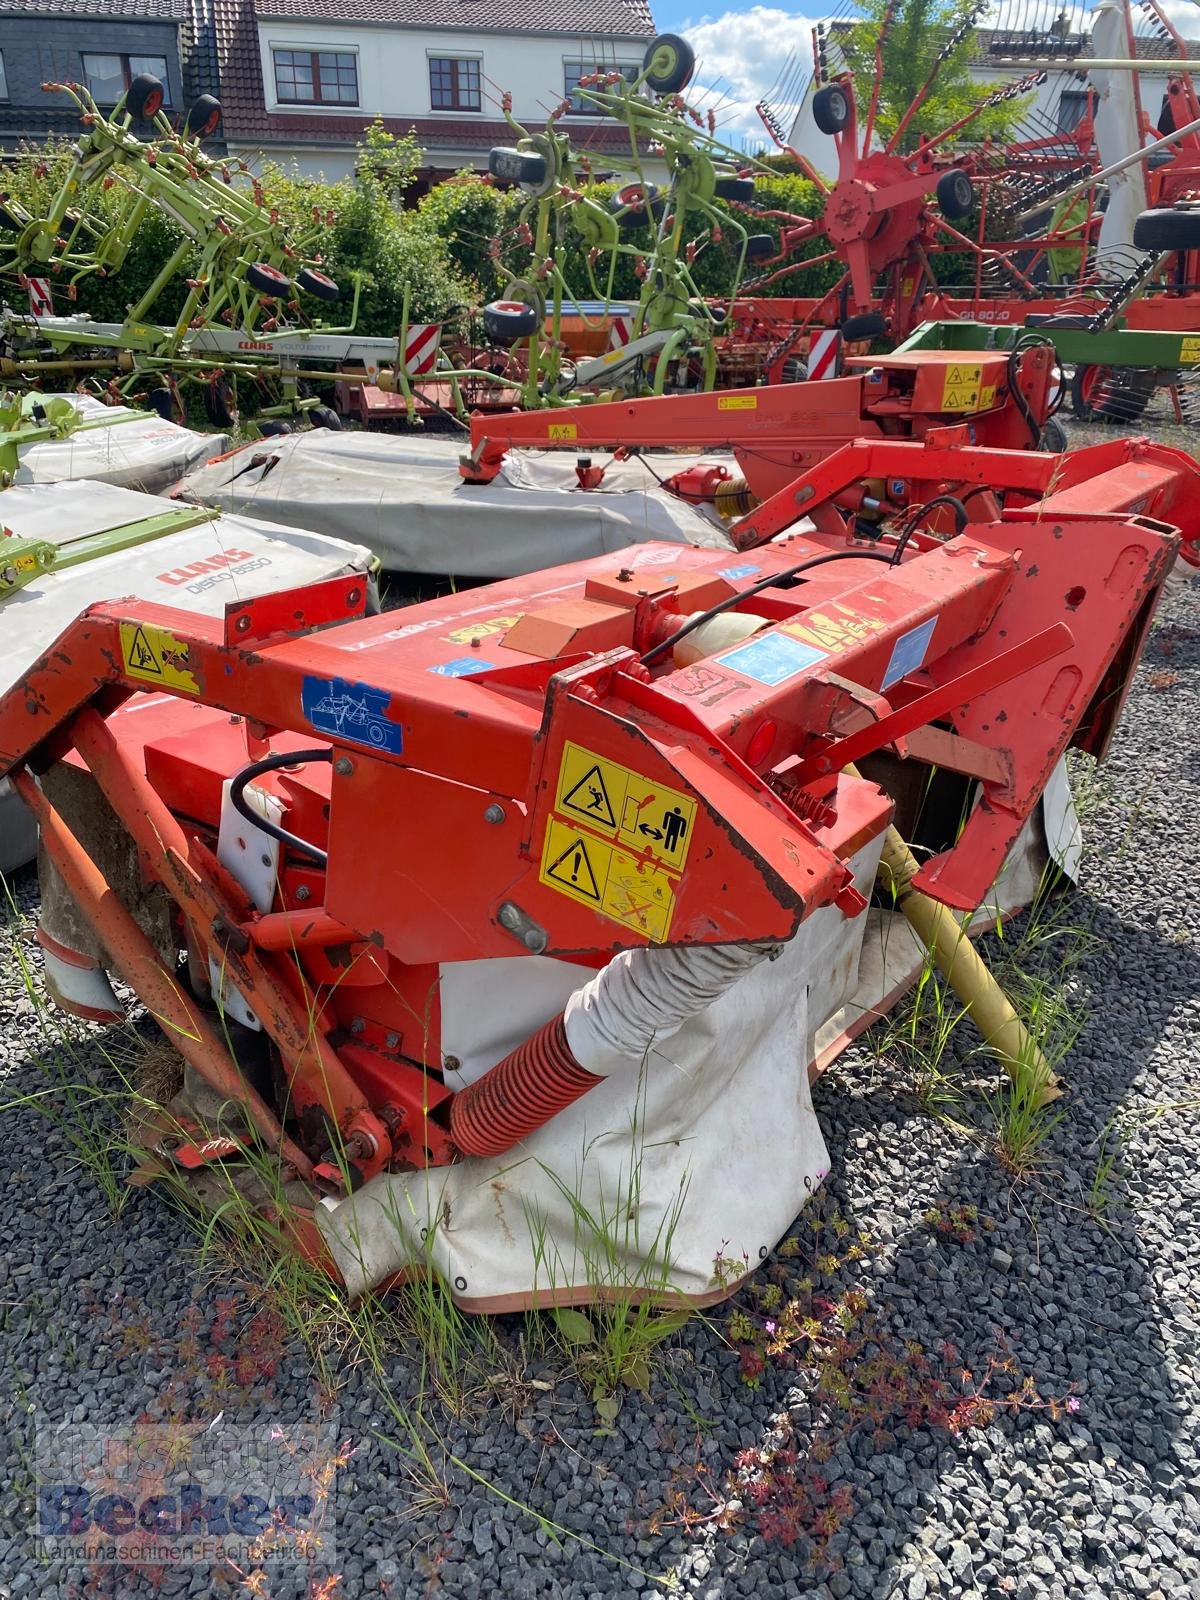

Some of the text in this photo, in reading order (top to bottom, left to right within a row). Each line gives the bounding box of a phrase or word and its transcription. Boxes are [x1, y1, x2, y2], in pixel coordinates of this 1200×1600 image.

[238, 341, 274, 350] CLAAS
[155, 548, 255, 586] CLAAS
[185, 557, 273, 594] DISCO 8550
